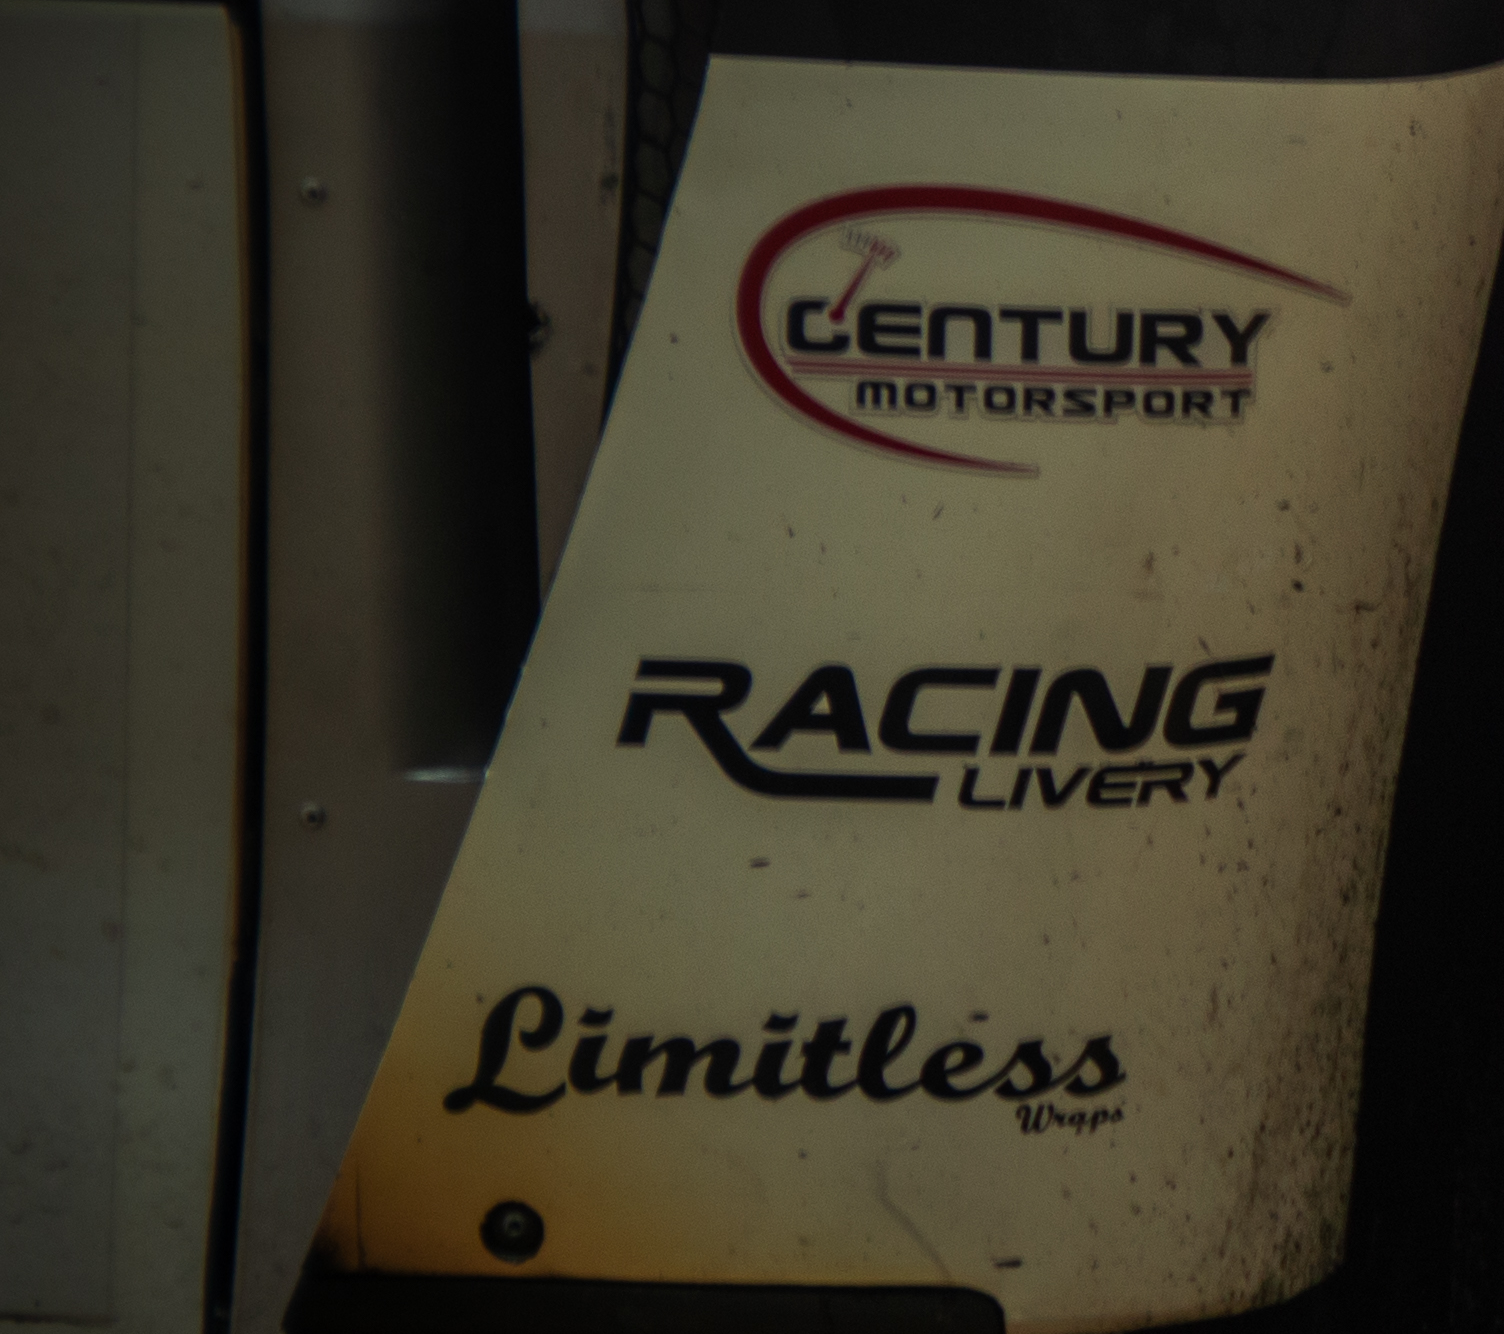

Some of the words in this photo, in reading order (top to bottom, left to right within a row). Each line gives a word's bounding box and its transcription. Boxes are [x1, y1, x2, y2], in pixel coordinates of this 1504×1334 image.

[787, 297, 1272, 366] CENTURY
[856, 379, 1256, 420] MOTORSPORT
[617, 654, 1274, 801] RACING
[959, 755, 1244, 810] LIVERY
[444, 983, 1128, 1113] Limitless
[1016, 1100, 1128, 1135] Wraps
